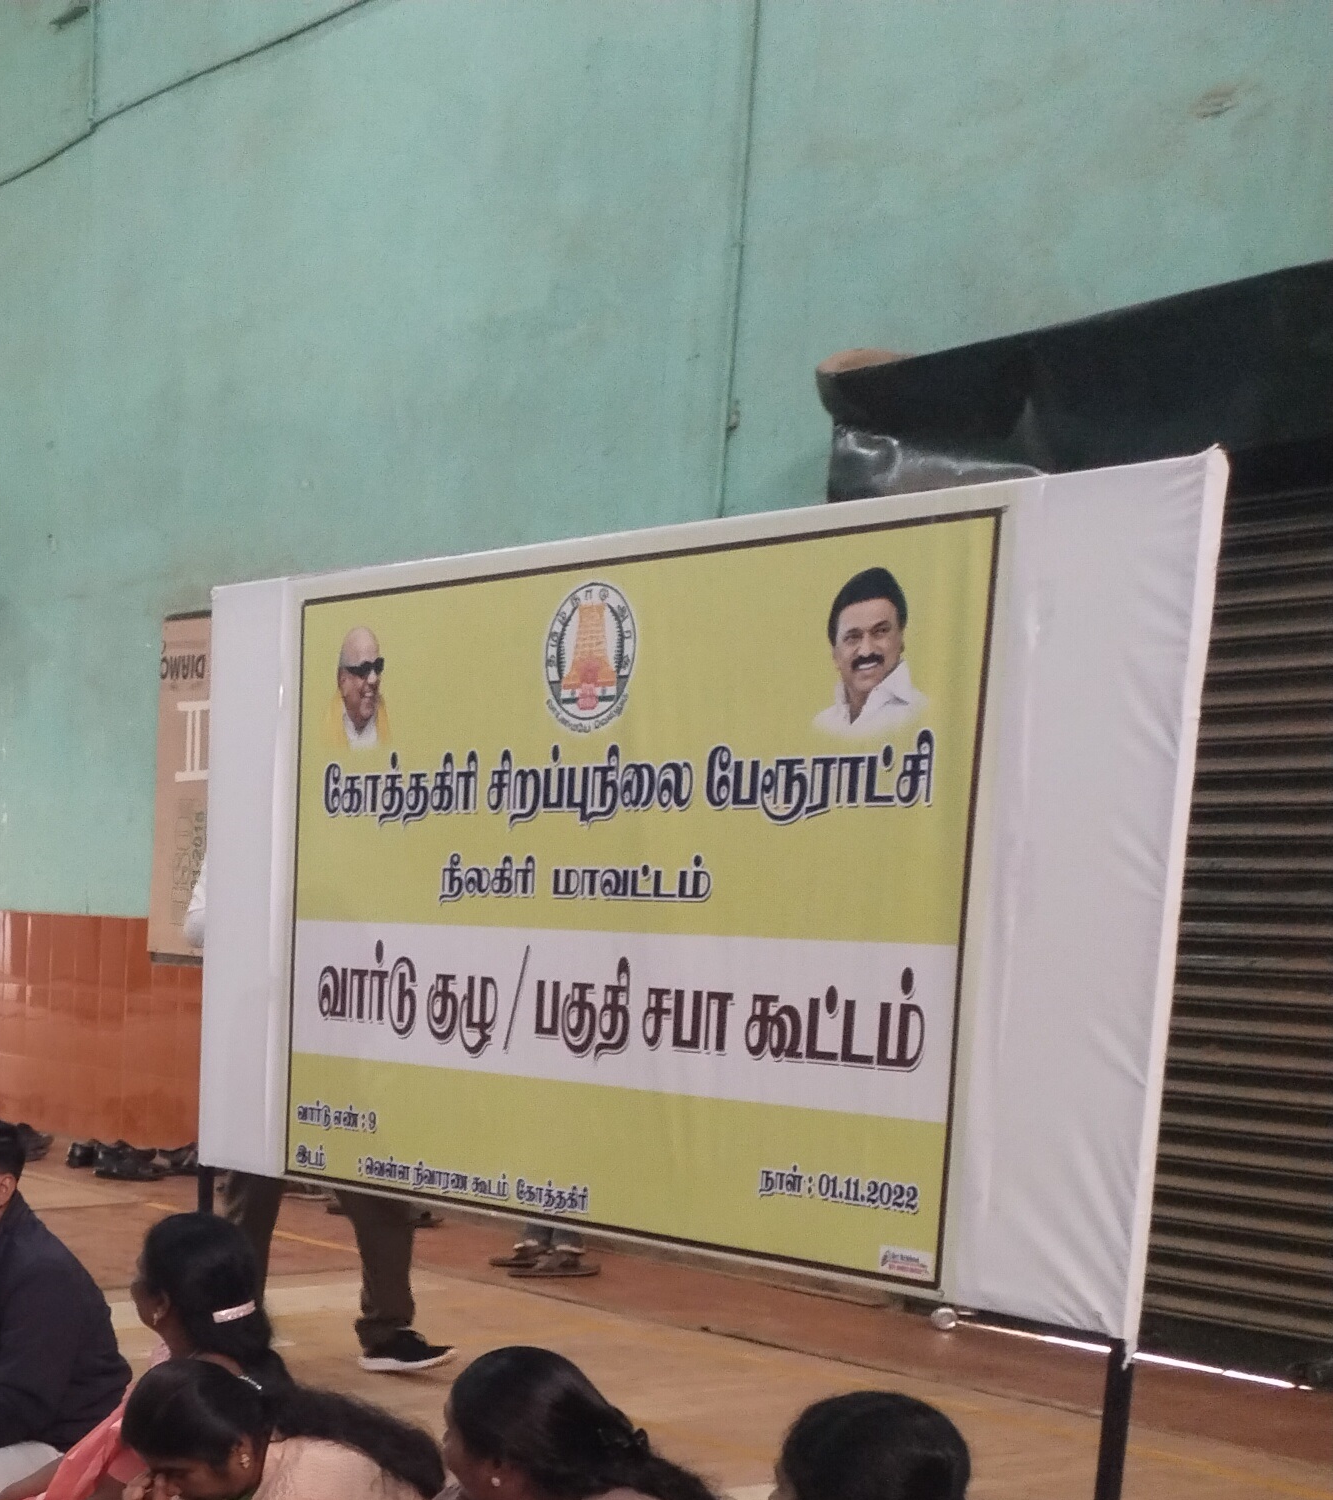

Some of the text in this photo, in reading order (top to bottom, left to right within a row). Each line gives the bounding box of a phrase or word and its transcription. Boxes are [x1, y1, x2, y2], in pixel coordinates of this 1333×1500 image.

[324, 729, 934, 828] கோத்தகிரி சிறப்புநிலை பேரூராட்சி
[439, 853, 712, 903] நீலகிரி மாவட்டம்
[318, 939, 416, 1038] வார்டு
[427, 973, 499, 1058] குழு
[534, 956, 631, 1062] பகுதி
[642, 986, 735, 1056] சபா
[745, 966, 925, 1072] கூட்டம்
[297, 1100, 331, 1130] வார்டு
[333, 1104, 359, 1131] எண்
[368, 1111, 377, 1132] 9
[296, 1144, 326, 1169] இடம்
[365, 1156, 411, 1181] வெள்ள
[413, 1161, 468, 1192] நிவாரண
[471, 1173, 509, 1198] கூடம்
[516, 1178, 589, 1211] கோத்தகிரி
[759, 1164, 803, 1197] நாள்
[818, 1173, 919, 1213] 01.11.2022
